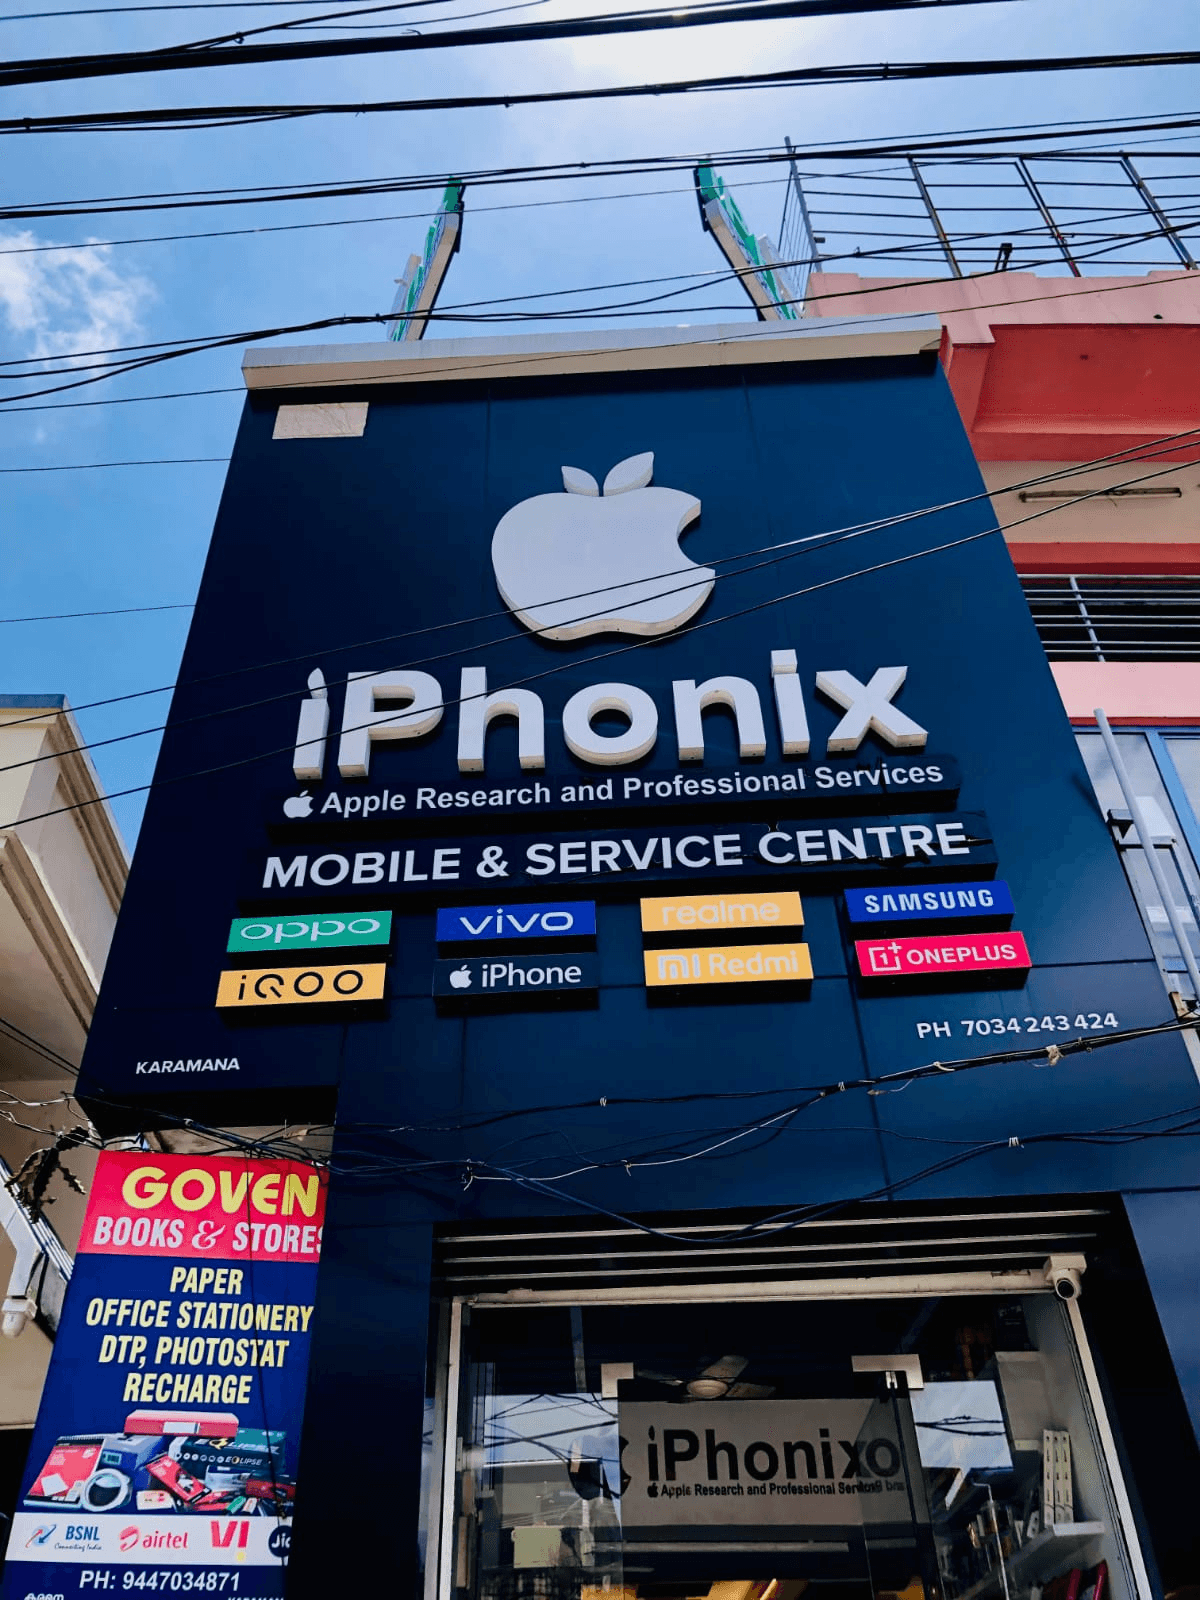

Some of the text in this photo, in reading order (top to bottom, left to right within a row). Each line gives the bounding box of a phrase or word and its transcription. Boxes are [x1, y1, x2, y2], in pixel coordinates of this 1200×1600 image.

[293, 649, 929, 780] iPhonix
[320, 763, 944, 818] Apple Research and Professional Services
[262, 822, 970, 889] MOBILE & SERVICE CENTRE
[662, 900, 781, 927] realme
[864, 889, 994, 915] SAMSUNG
[240, 917, 381, 944] oppo
[459, 907, 575, 935] vivo
[708, 949, 799, 976] Redmi
[906, 944, 1018, 965] ONEPLUS
[237, 969, 364, 1000] iQOO
[481, 963, 583, 988] iPhone
[916, 1012, 1119, 1040] PH 7034 243 424
[135, 1057, 240, 1074] KARAMANA
[121, 1166, 320, 1218] GOVEN
[92, 1216, 185, 1249] BOOKS
[191, 1220, 226, 1250] &
[169, 1266, 244, 1295] PAPER
[86, 1298, 314, 1332] OFFICE STATIONERY
[98, 1335, 290, 1369] DTP, PHOTOSTAT
[122, 1372, 253, 1404] RECHARGE
[661, 1484, 691, 1498] Apple
[695, 1483, 744, 1497] Research
[747, 1482, 767, 1496] and
[769, 1481, 836, 1496] Professional
[65, 1525, 101, 1541] BSNL
[142, 1530, 189, 1550] airtel
[79, 1570, 240, 1592] PH: 9447034871
